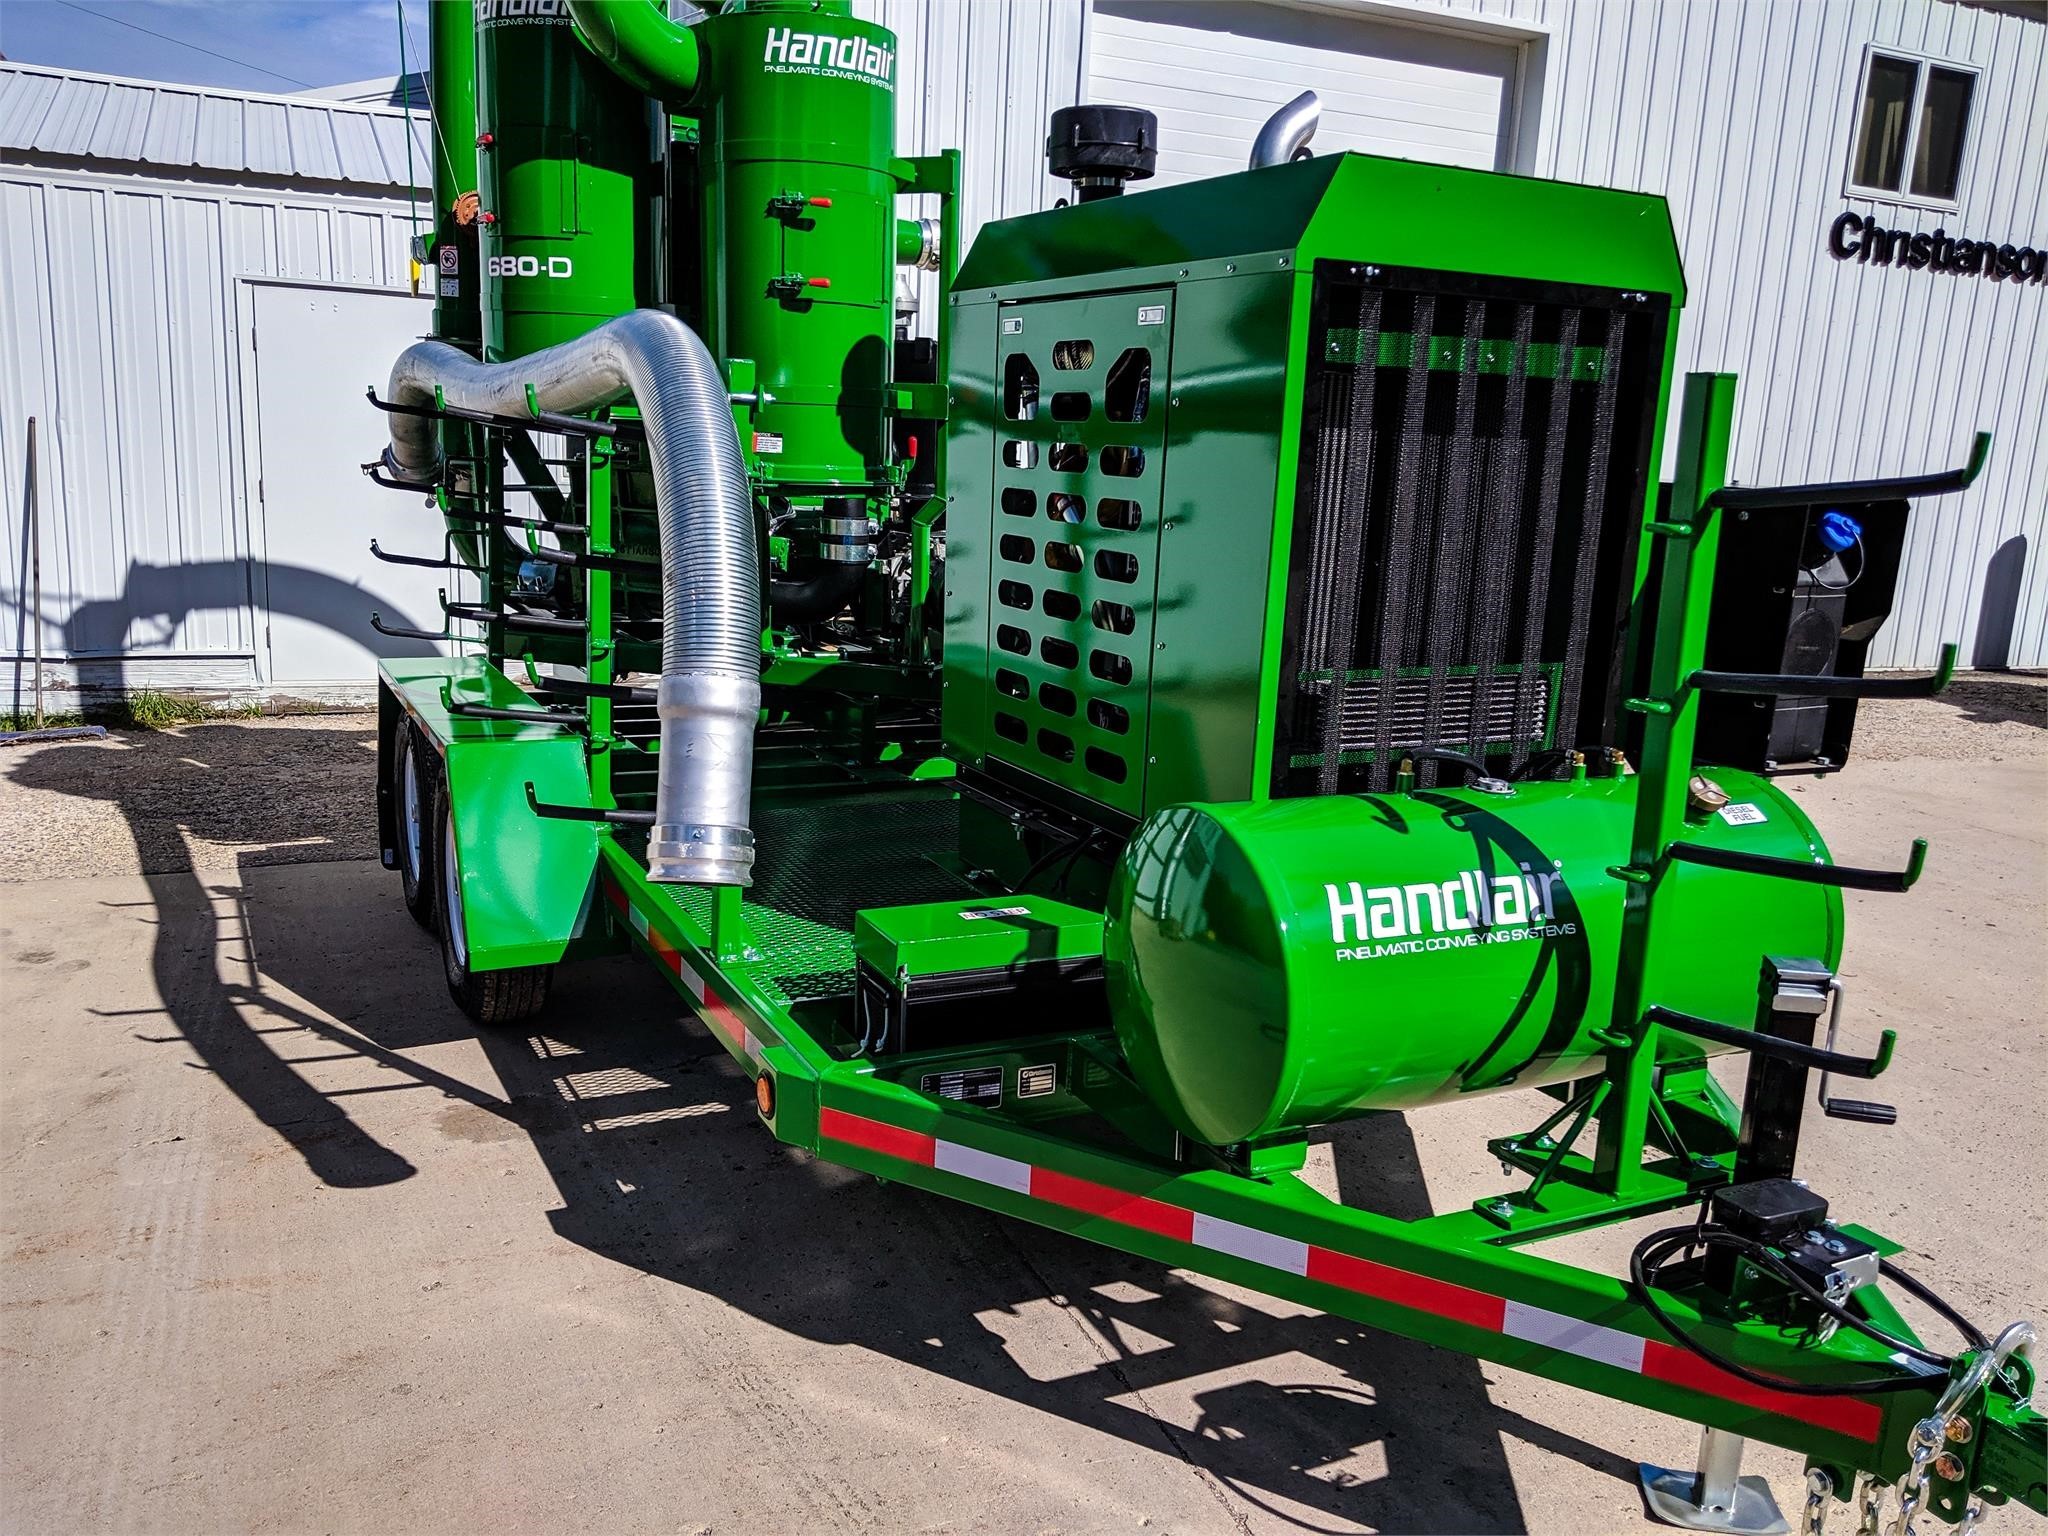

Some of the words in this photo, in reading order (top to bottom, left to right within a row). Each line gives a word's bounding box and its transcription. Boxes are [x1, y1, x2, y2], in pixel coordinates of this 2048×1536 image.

[497, 17, 545, 27] CONVEYING
[545, 17, 576, 27] SYSTE
[764, 27, 895, 80] Handlair
[764, 65, 820, 76] PNEUMATIC
[821, 68, 871, 83] CONVEYING
[870, 77, 894, 93] SYSTEMS
[488, 256, 573, 278] 680-D
[1732, 813, 1757, 821] FUEL
[1323, 861, 1561, 943] Handlair
[1336, 940, 1424, 962] PNEUMATIC
[1425, 930, 1511, 952] CONVEYING
[1511, 923, 1577, 942] SYSTEMS
